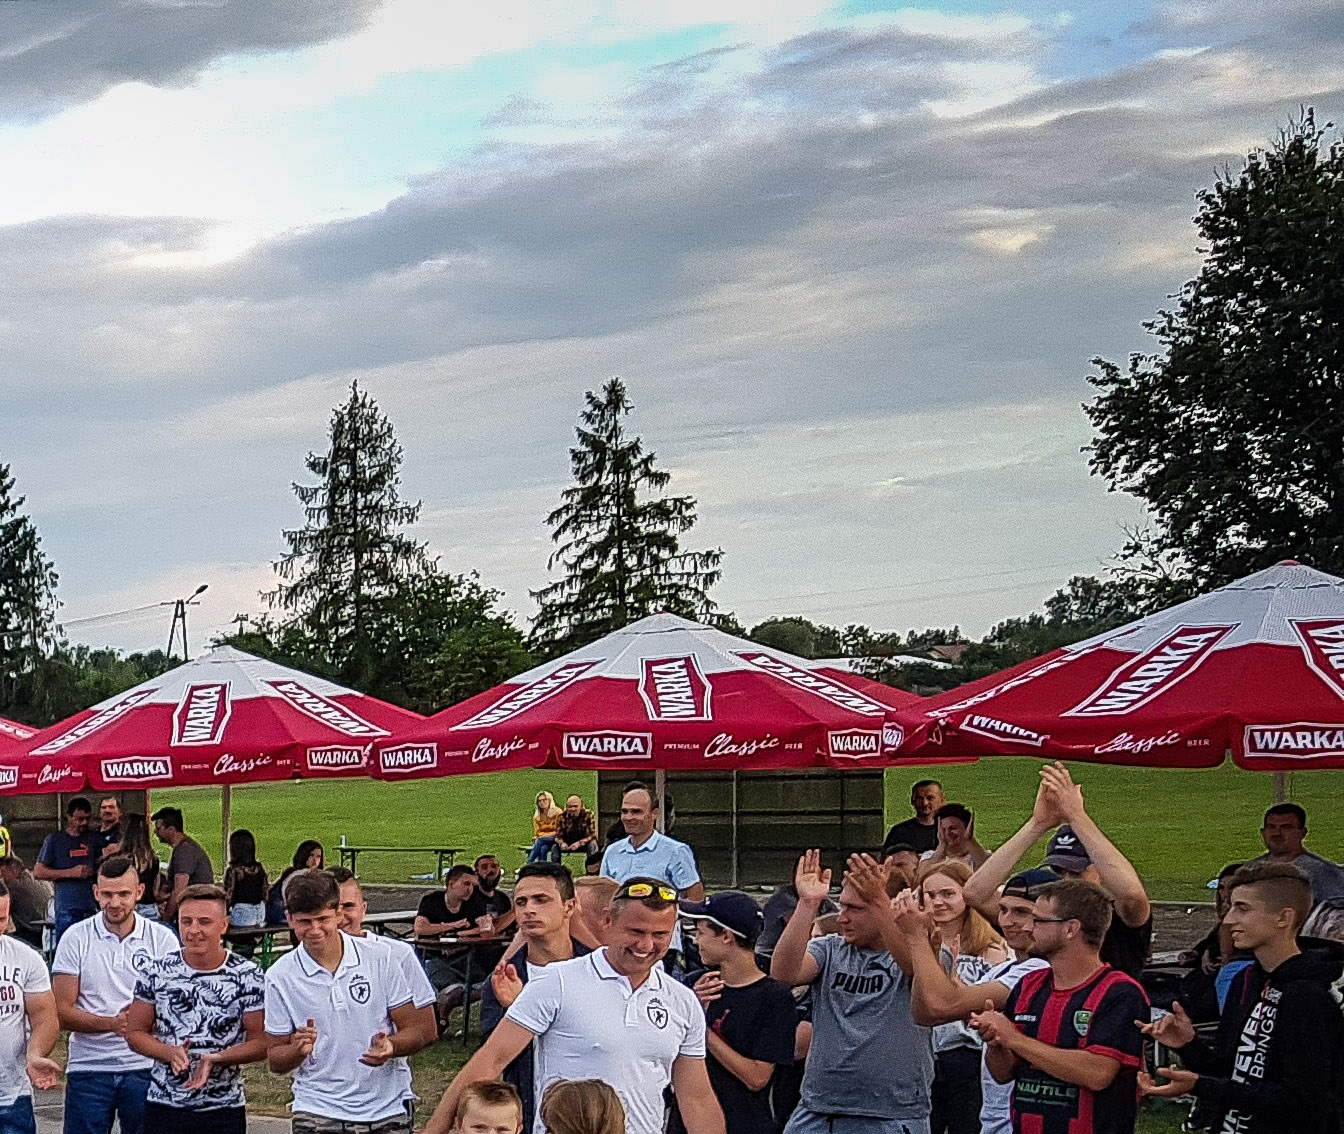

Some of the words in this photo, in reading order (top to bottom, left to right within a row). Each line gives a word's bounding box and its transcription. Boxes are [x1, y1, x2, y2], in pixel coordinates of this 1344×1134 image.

[1308, 622, 1344, 682] RKA
[751, 655, 880, 713] WARKA
[1083, 628, 1224, 713] WARKA
[472, 663, 585, 727] WARKA
[652, 658, 696, 718] WARKA
[183, 684, 223, 742] WARKA
[277, 682, 370, 735] WARKA
[384, 748, 433, 767] WARKA
[471, 735, 526, 764] Classic
[569, 736, 645, 754] WARKA
[703, 732, 781, 759] Classic
[831, 734, 877, 752] WARKA
[1252, 730, 1344, 751] WARKA
[105, 760, 167, 777] WARKA
[213, 752, 273, 777] Classic
[311, 748, 361, 766] WARKA
[37, 764, 73, 785] Classic
[0, 985, 16, 1001] 60
[831, 971, 884, 994] PUMA
[1248, 1004, 1278, 1079] BRINGS
